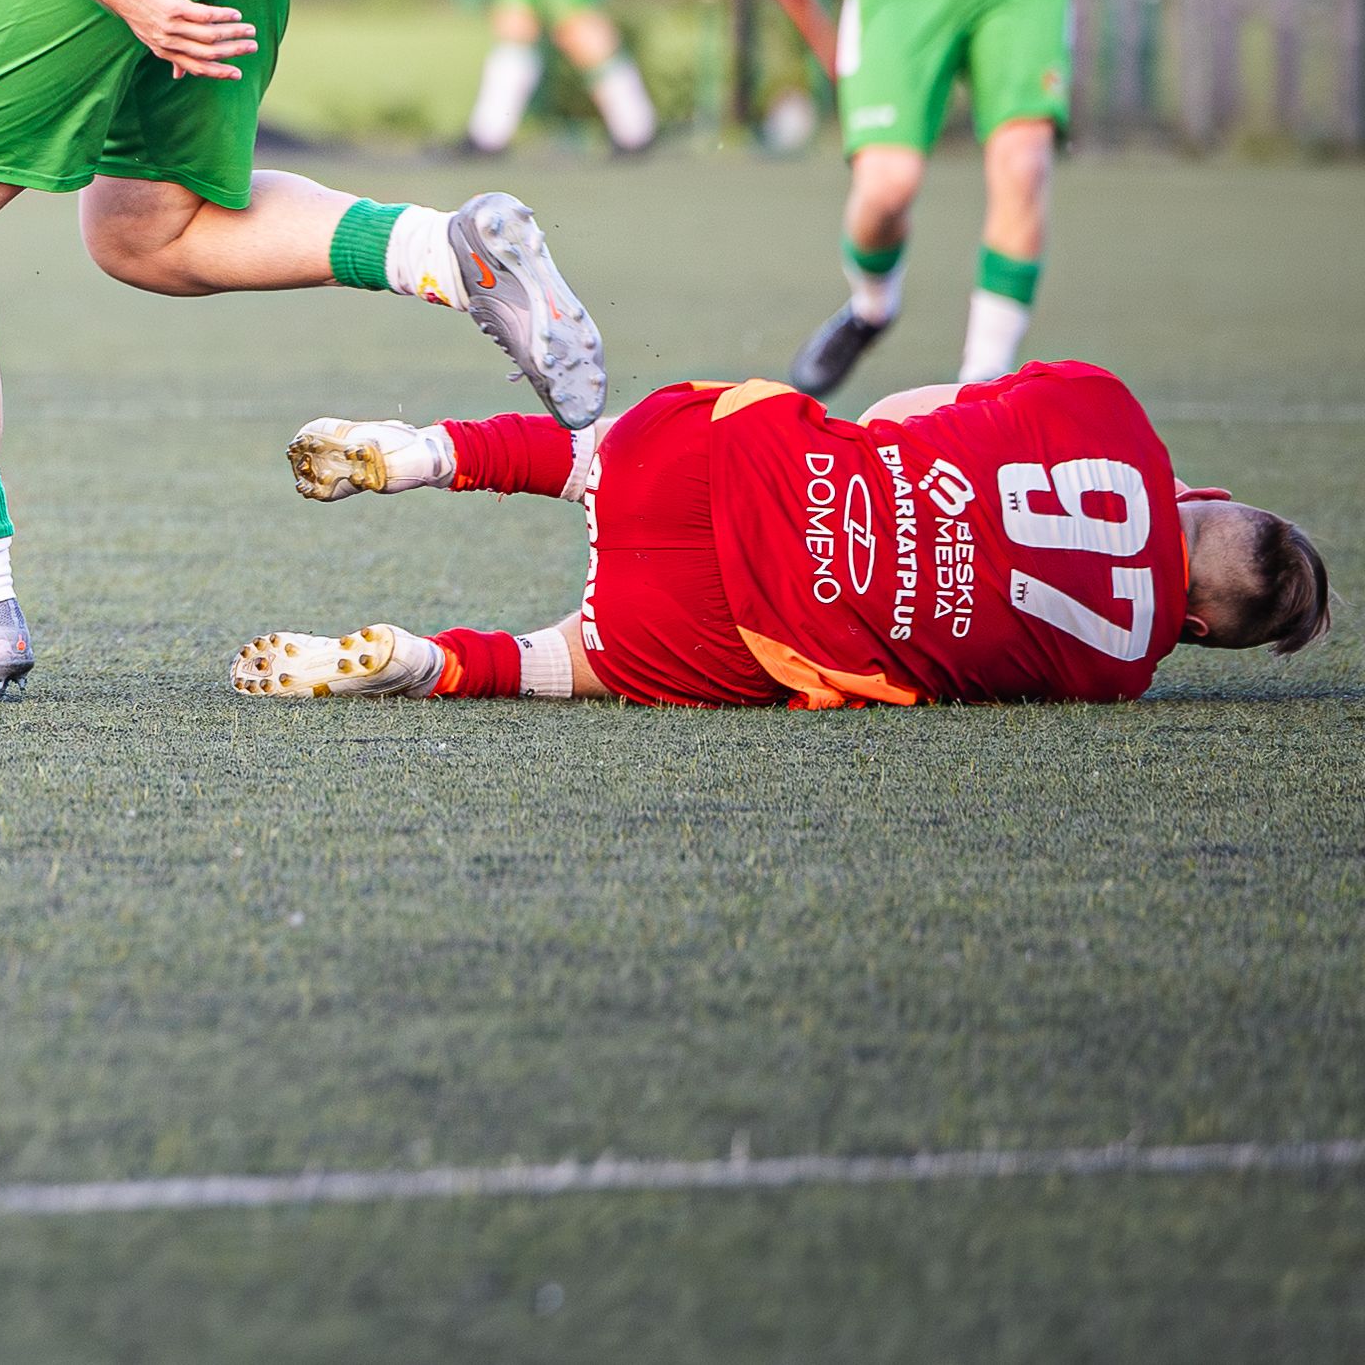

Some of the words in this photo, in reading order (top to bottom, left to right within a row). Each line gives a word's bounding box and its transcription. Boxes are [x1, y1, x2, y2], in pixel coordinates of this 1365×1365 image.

[805, 453, 841, 603] DOMENO
[934, 517, 954, 619] MEDIA
[952, 520, 976, 638] BESKID
[997, 458, 1155, 662] 97
